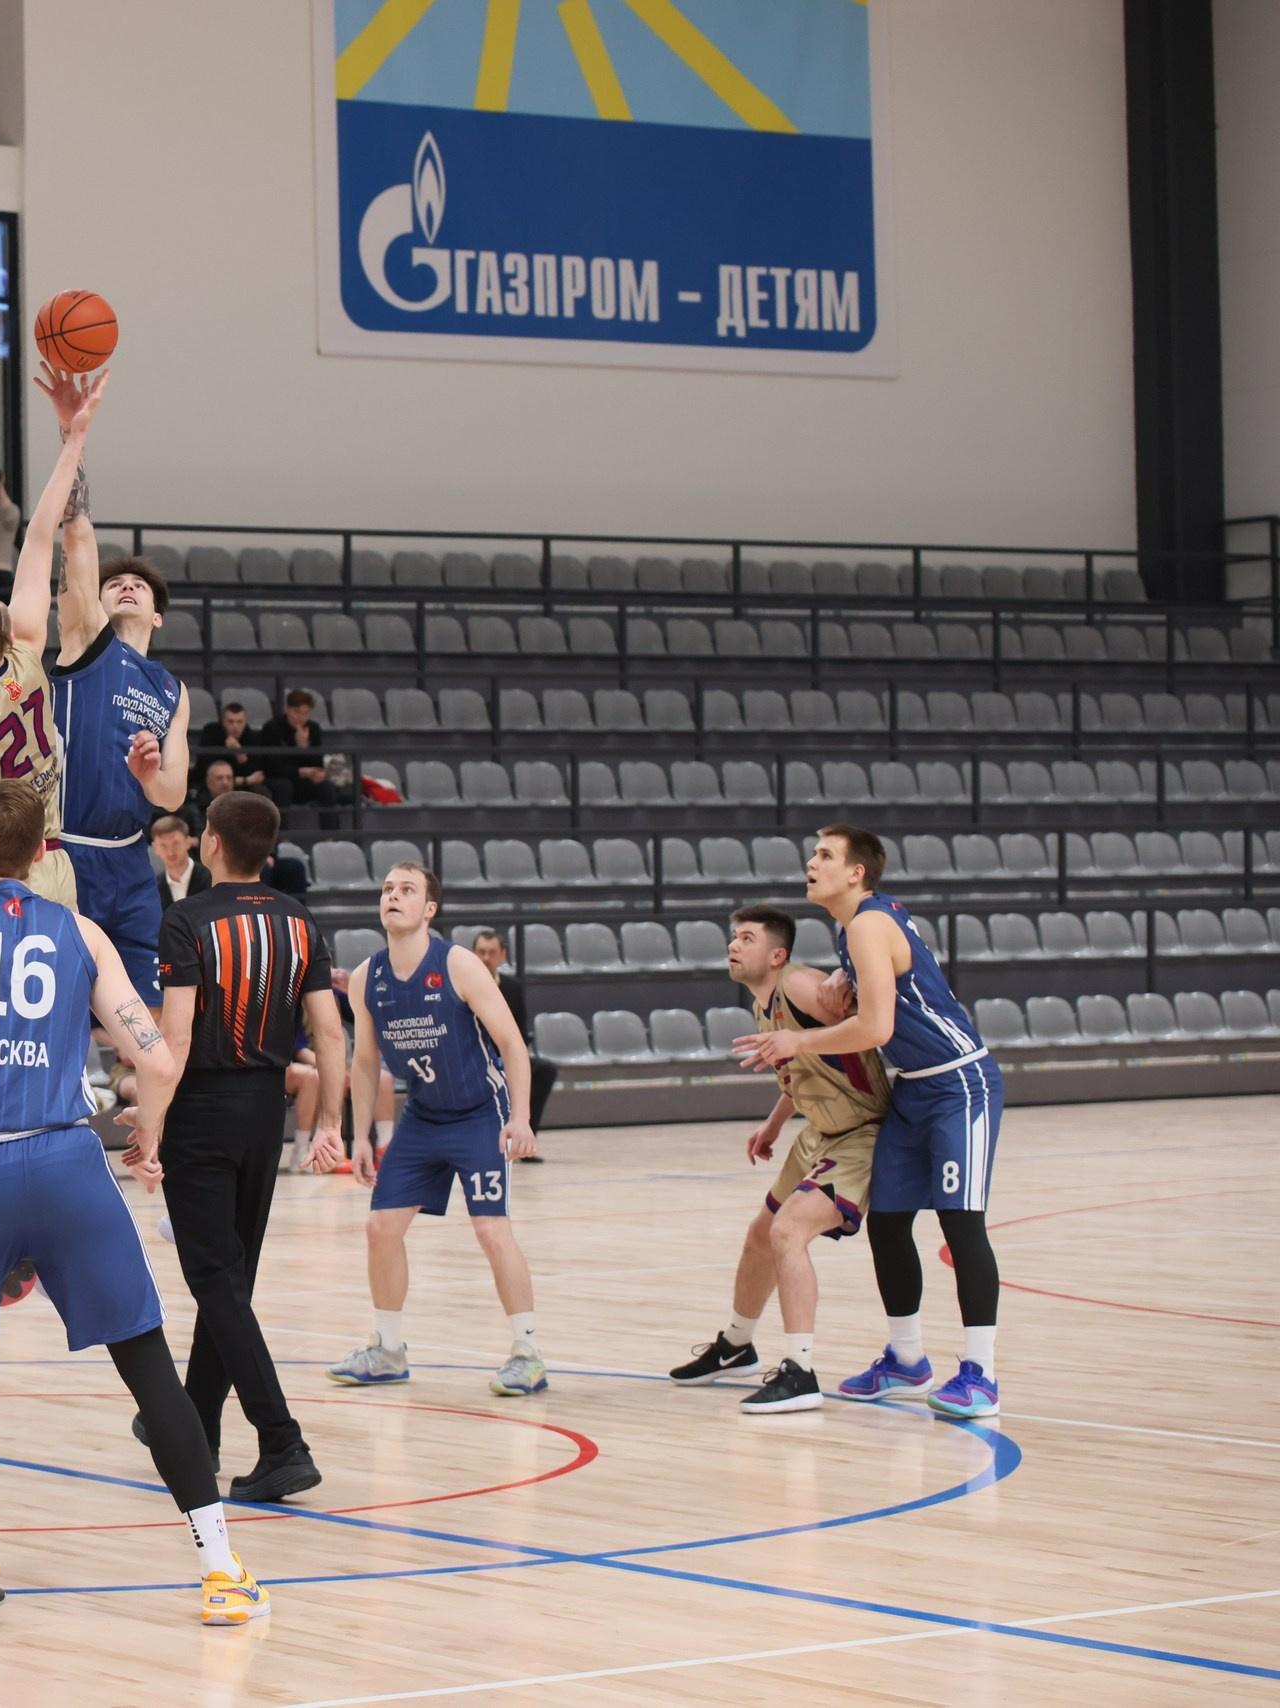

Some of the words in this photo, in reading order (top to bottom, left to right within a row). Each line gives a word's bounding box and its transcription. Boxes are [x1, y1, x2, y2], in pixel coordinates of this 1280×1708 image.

[455, 249, 659, 323] ГАЗПРОМ
[716, 264, 860, 337] ДЕТЯМ
[382, 1023, 448, 1041] ГОСУДАРСТВЕННЫЙ
[387, 1014, 434, 1030] МОСКОВСКИЙ
[393, 1038, 439, 1050] УНИВЕРСИТЕТ
[407, 1054, 436, 1083] 13
[470, 1170, 503, 1202] 13
[942, 1160, 960, 1194] 8
